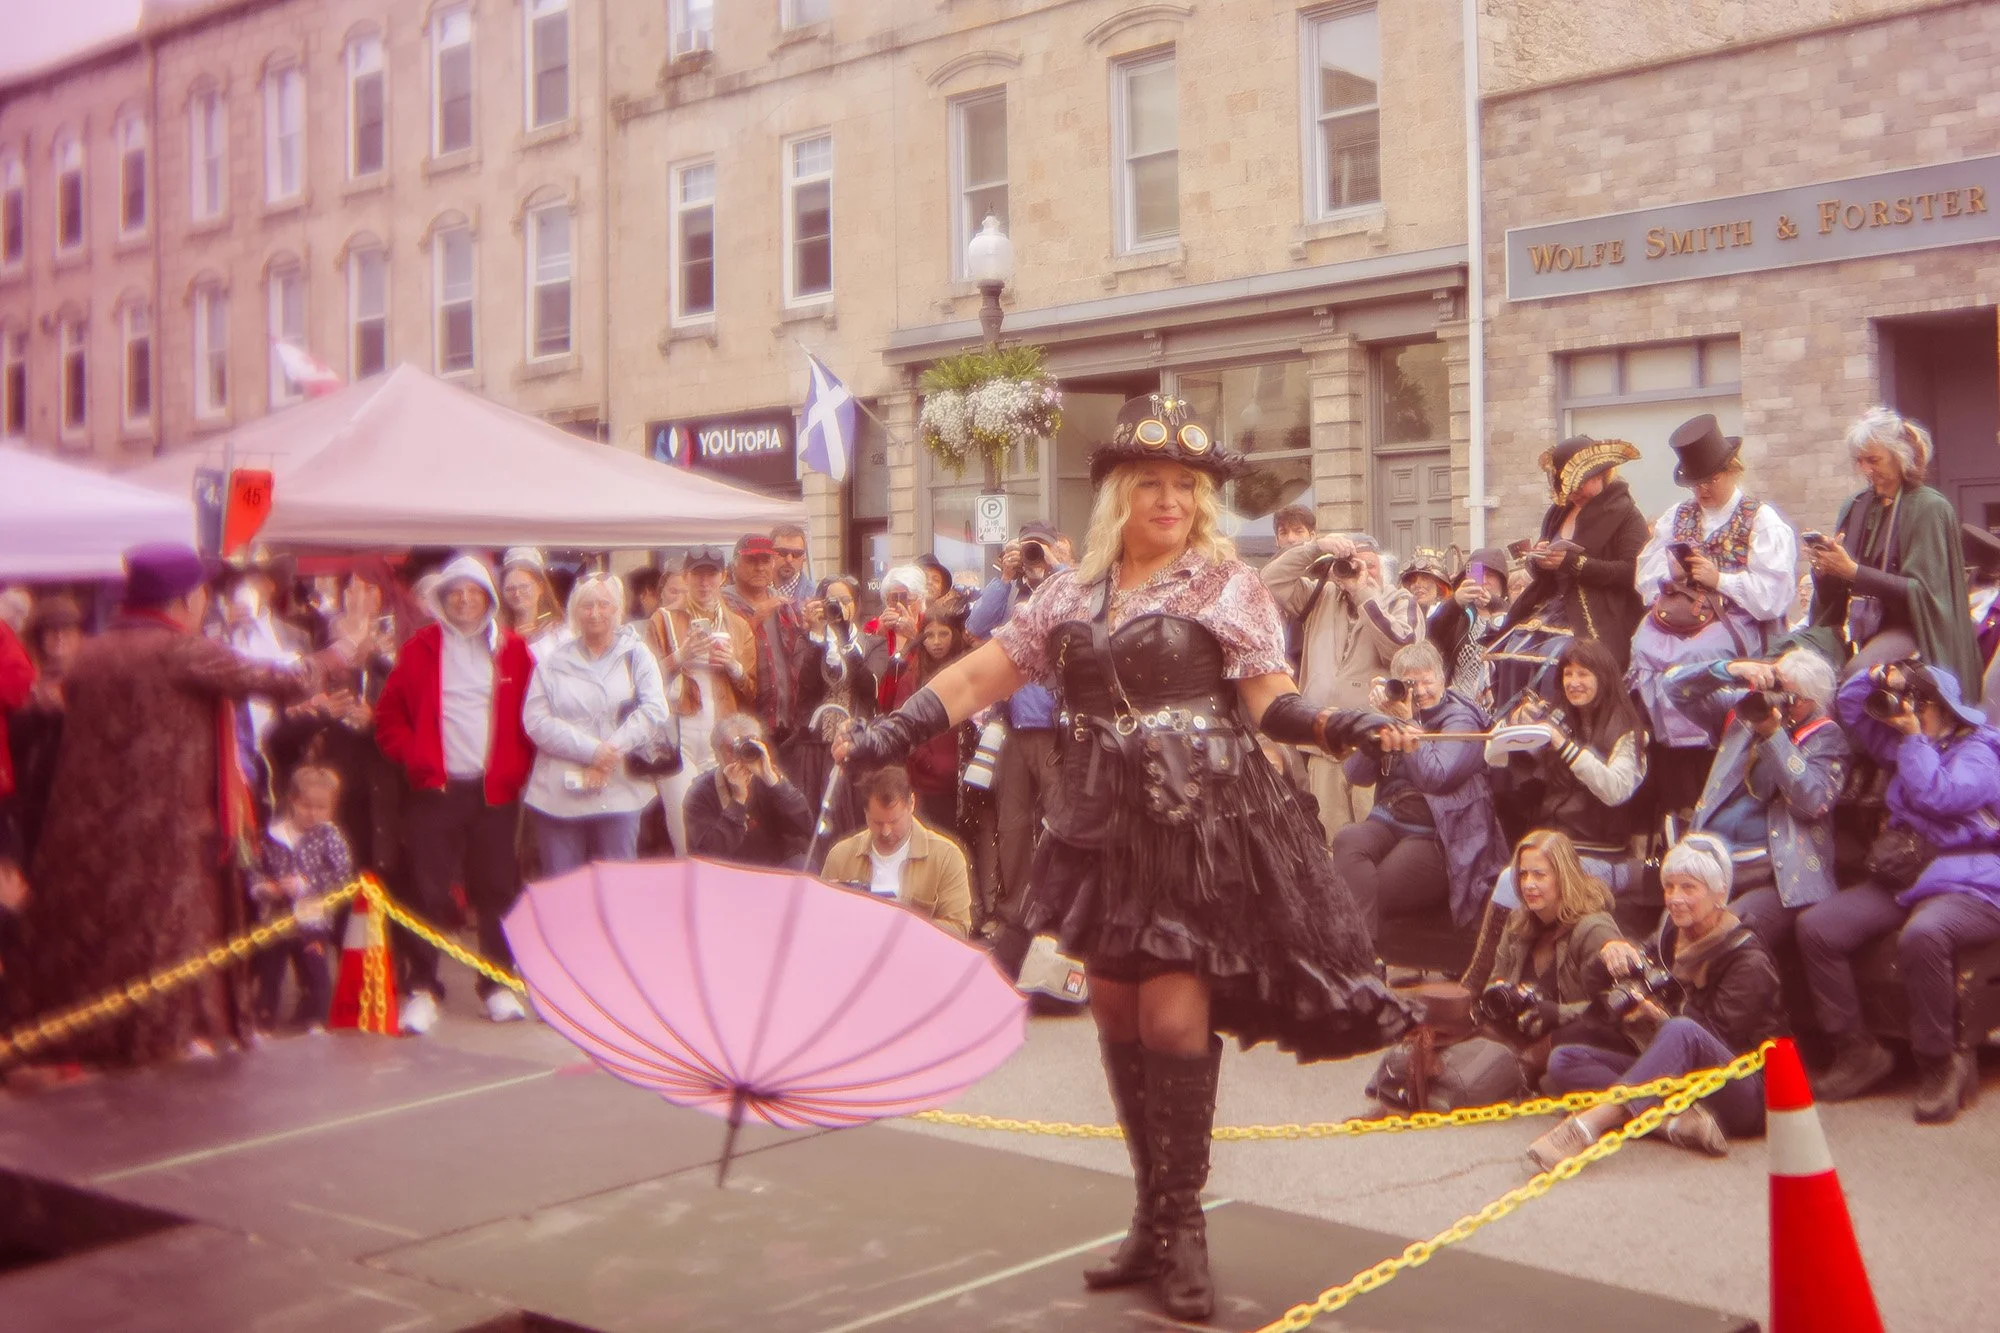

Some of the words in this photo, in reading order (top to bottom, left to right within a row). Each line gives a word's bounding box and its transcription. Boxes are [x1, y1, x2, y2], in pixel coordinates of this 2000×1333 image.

[1527, 239, 1625, 274] WOLFE
[1645, 219, 1753, 260] SMITH
[1776, 214, 1798, 241] &
[1817, 186, 1989, 235] FORSTER
[698, 428, 782, 456] YOUTOPIA
[242, 487, 261, 506] 45
[988, 503, 998, 514] P
